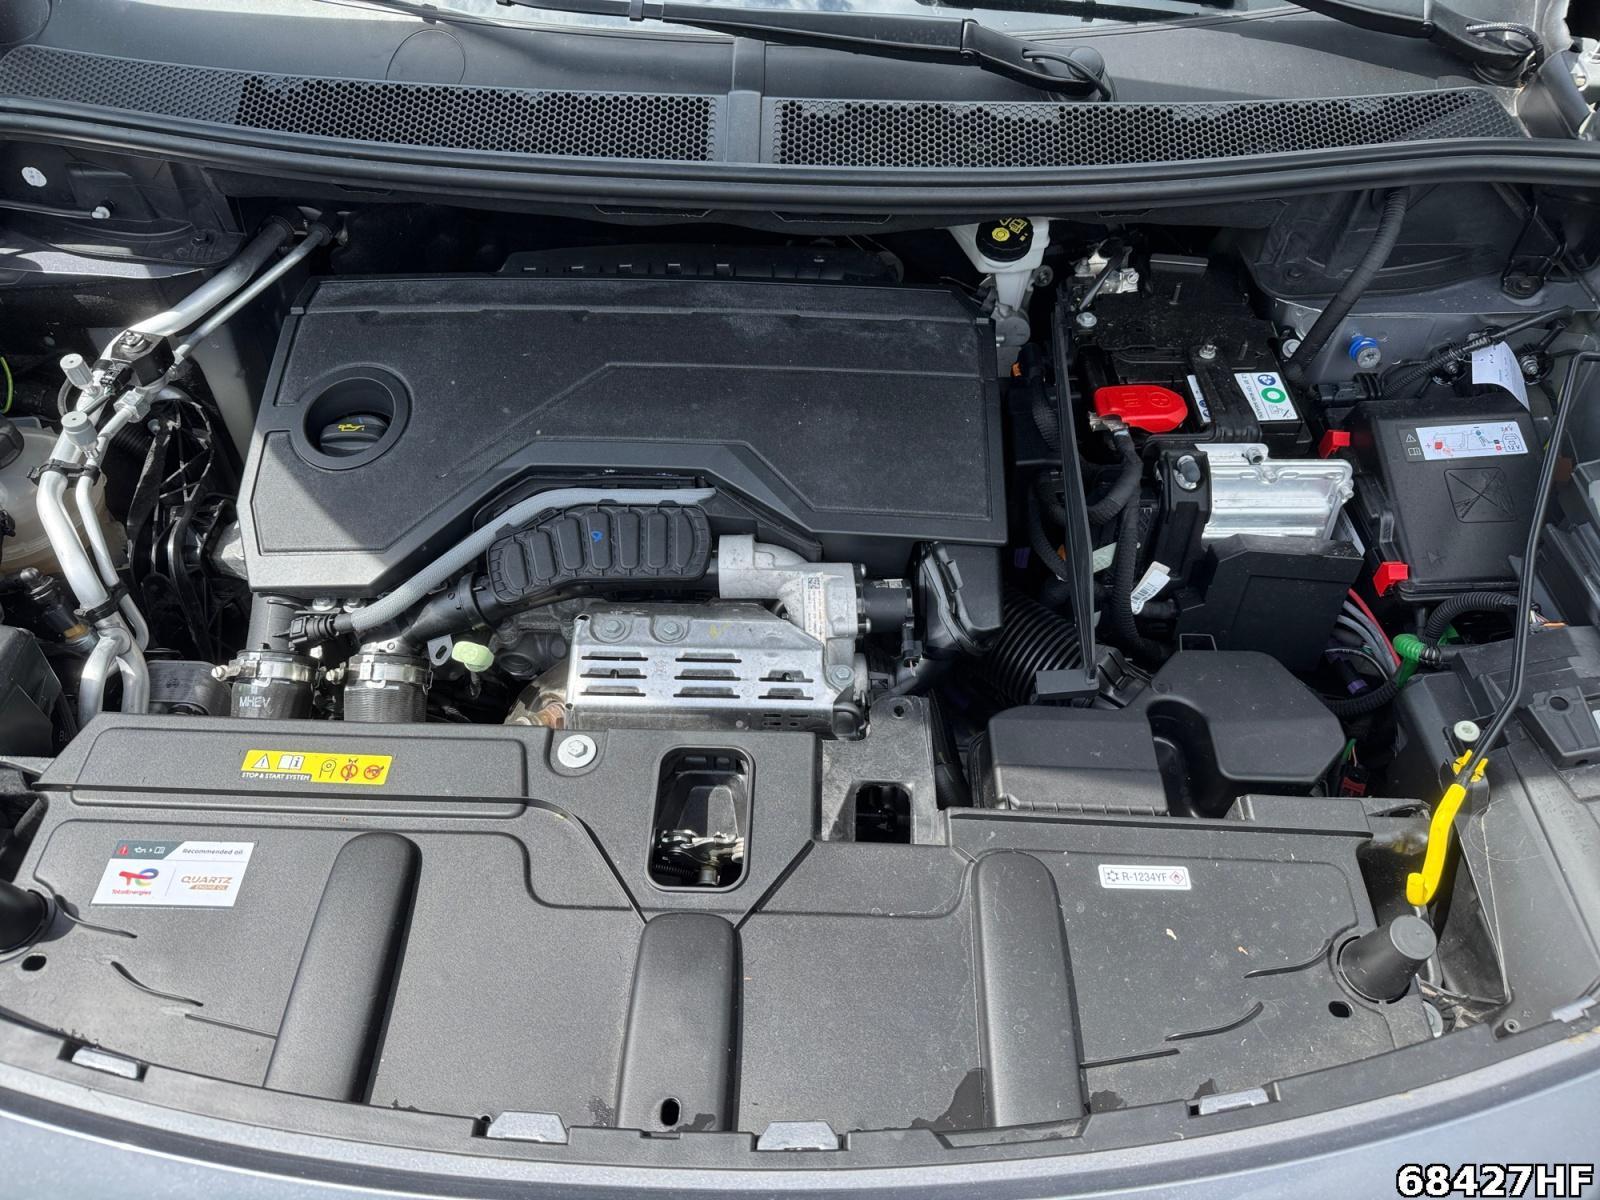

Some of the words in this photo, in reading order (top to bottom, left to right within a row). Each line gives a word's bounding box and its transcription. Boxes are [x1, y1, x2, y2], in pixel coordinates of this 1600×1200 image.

[239, 696, 271, 708] MHEV
[182, 848, 233, 856] Recommended
[181, 875, 233, 884] QUARTZ
[1121, 871, 1167, 882] R-1234YF
